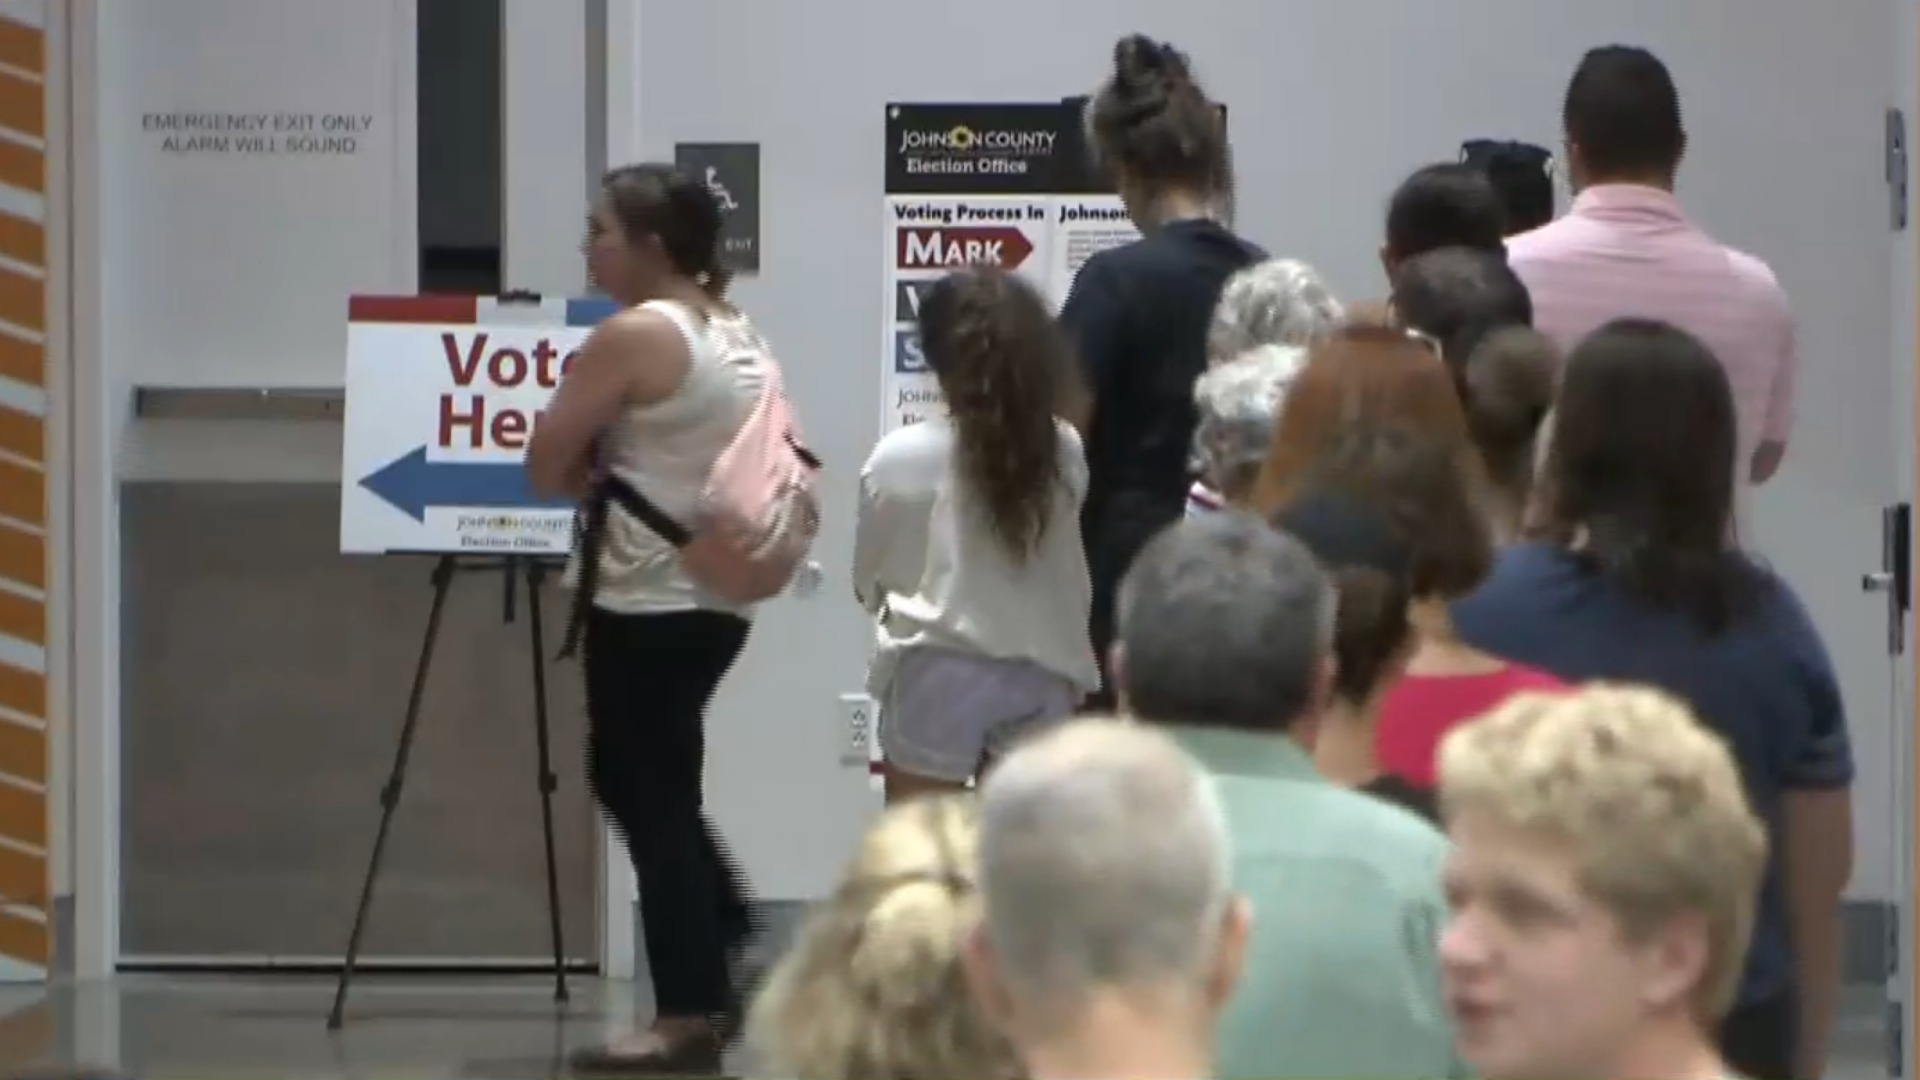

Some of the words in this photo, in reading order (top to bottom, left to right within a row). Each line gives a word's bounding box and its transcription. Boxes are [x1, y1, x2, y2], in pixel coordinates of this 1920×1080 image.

[142, 114, 267, 131] EMERGENCY
[273, 114, 314, 130] EXIT
[321, 115, 373, 130] ONLY
[162, 136, 229, 152] ALARM
[235, 136, 275, 152] WILL
[285, 137, 356, 153] SOUND
[900, 126, 983, 152] JOHNSON
[985, 130, 1056, 148] COUNTY
[907, 157, 974, 173] Election
[978, 158, 1027, 173] Office
[895, 204, 952, 222] Voting
[956, 204, 1022, 220] Process
[1027, 206, 1044, 220] In
